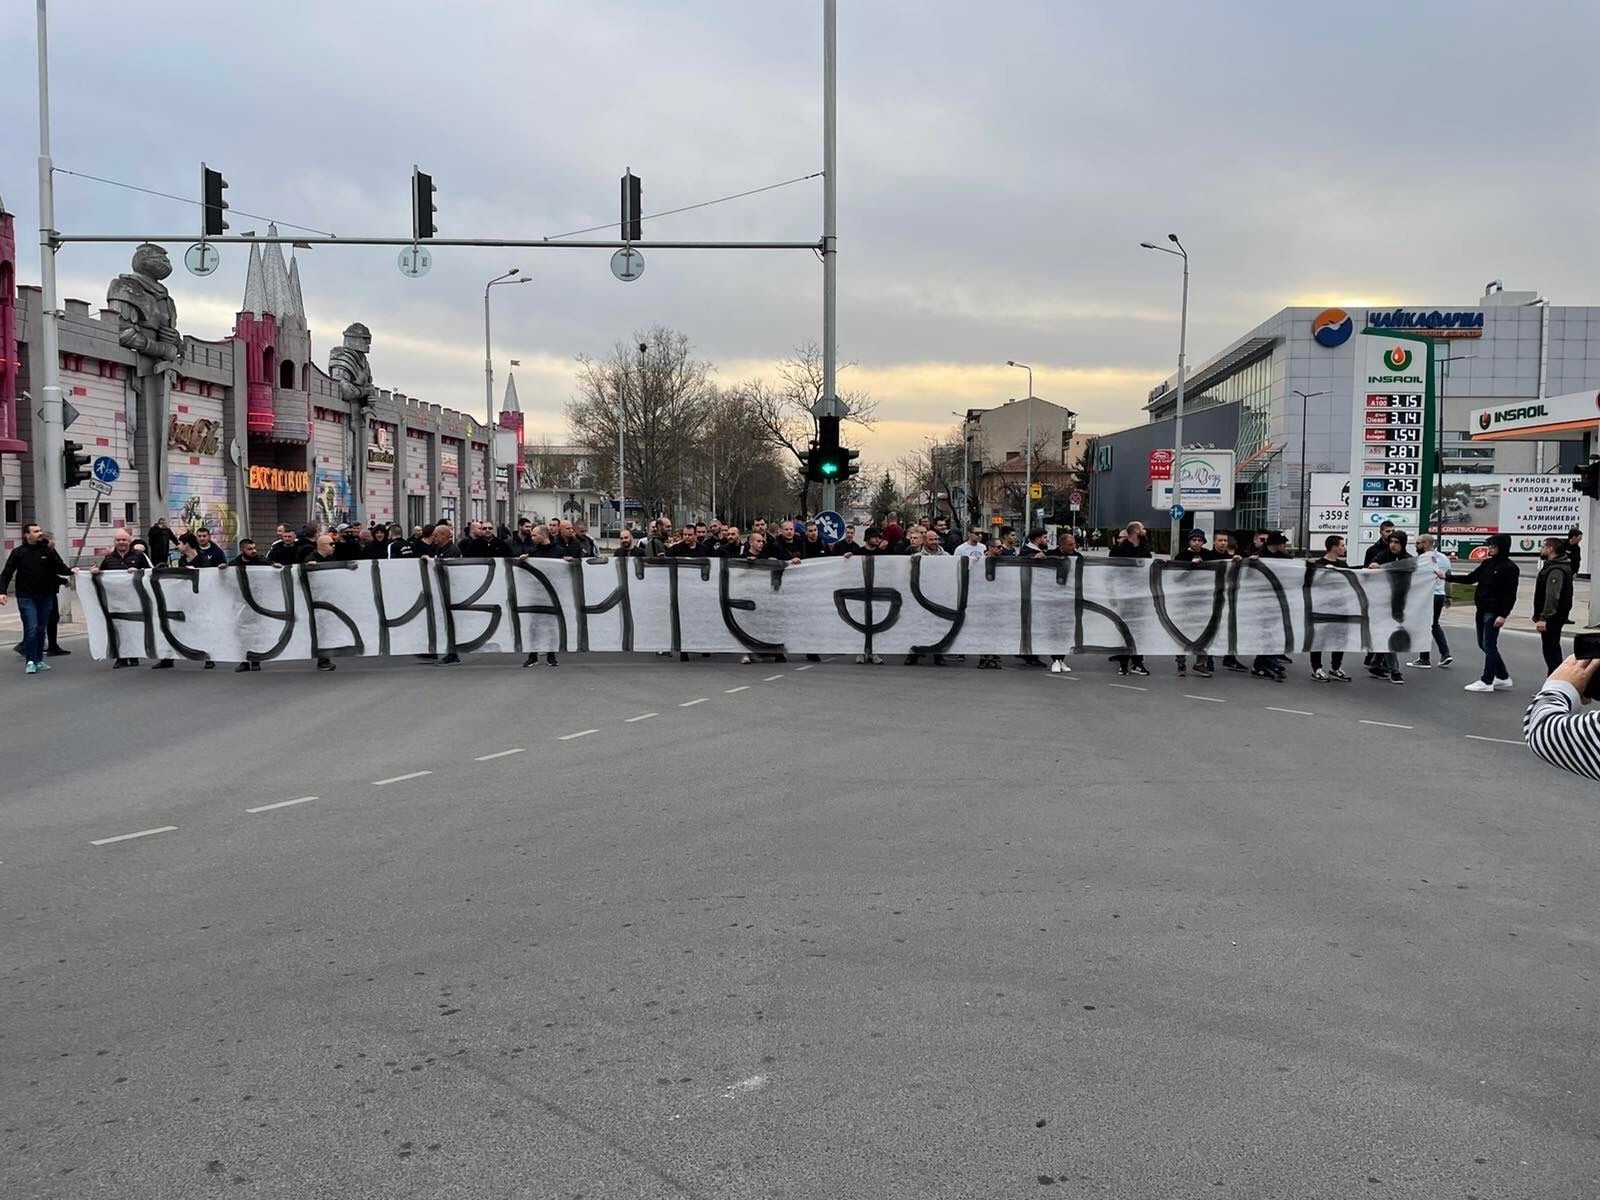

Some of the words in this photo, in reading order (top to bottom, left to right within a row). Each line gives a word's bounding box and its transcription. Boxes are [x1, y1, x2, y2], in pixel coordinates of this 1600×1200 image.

[1391, 395, 1418, 408] 3.15
[1391, 412, 1417, 424] 3.14
[1394, 429, 1416, 441] 1.54
[1389, 446, 1416, 458] 2.87
[1388, 463, 1415, 475] 2.97
[250, 465, 310, 492] EXCALIBUR
[1387, 480, 1414, 492] 2.75
[1391, 496, 1413, 508] 1.99
[1319, 510, 1343, 520] +359
[91, 564, 210, 660] НЕ
